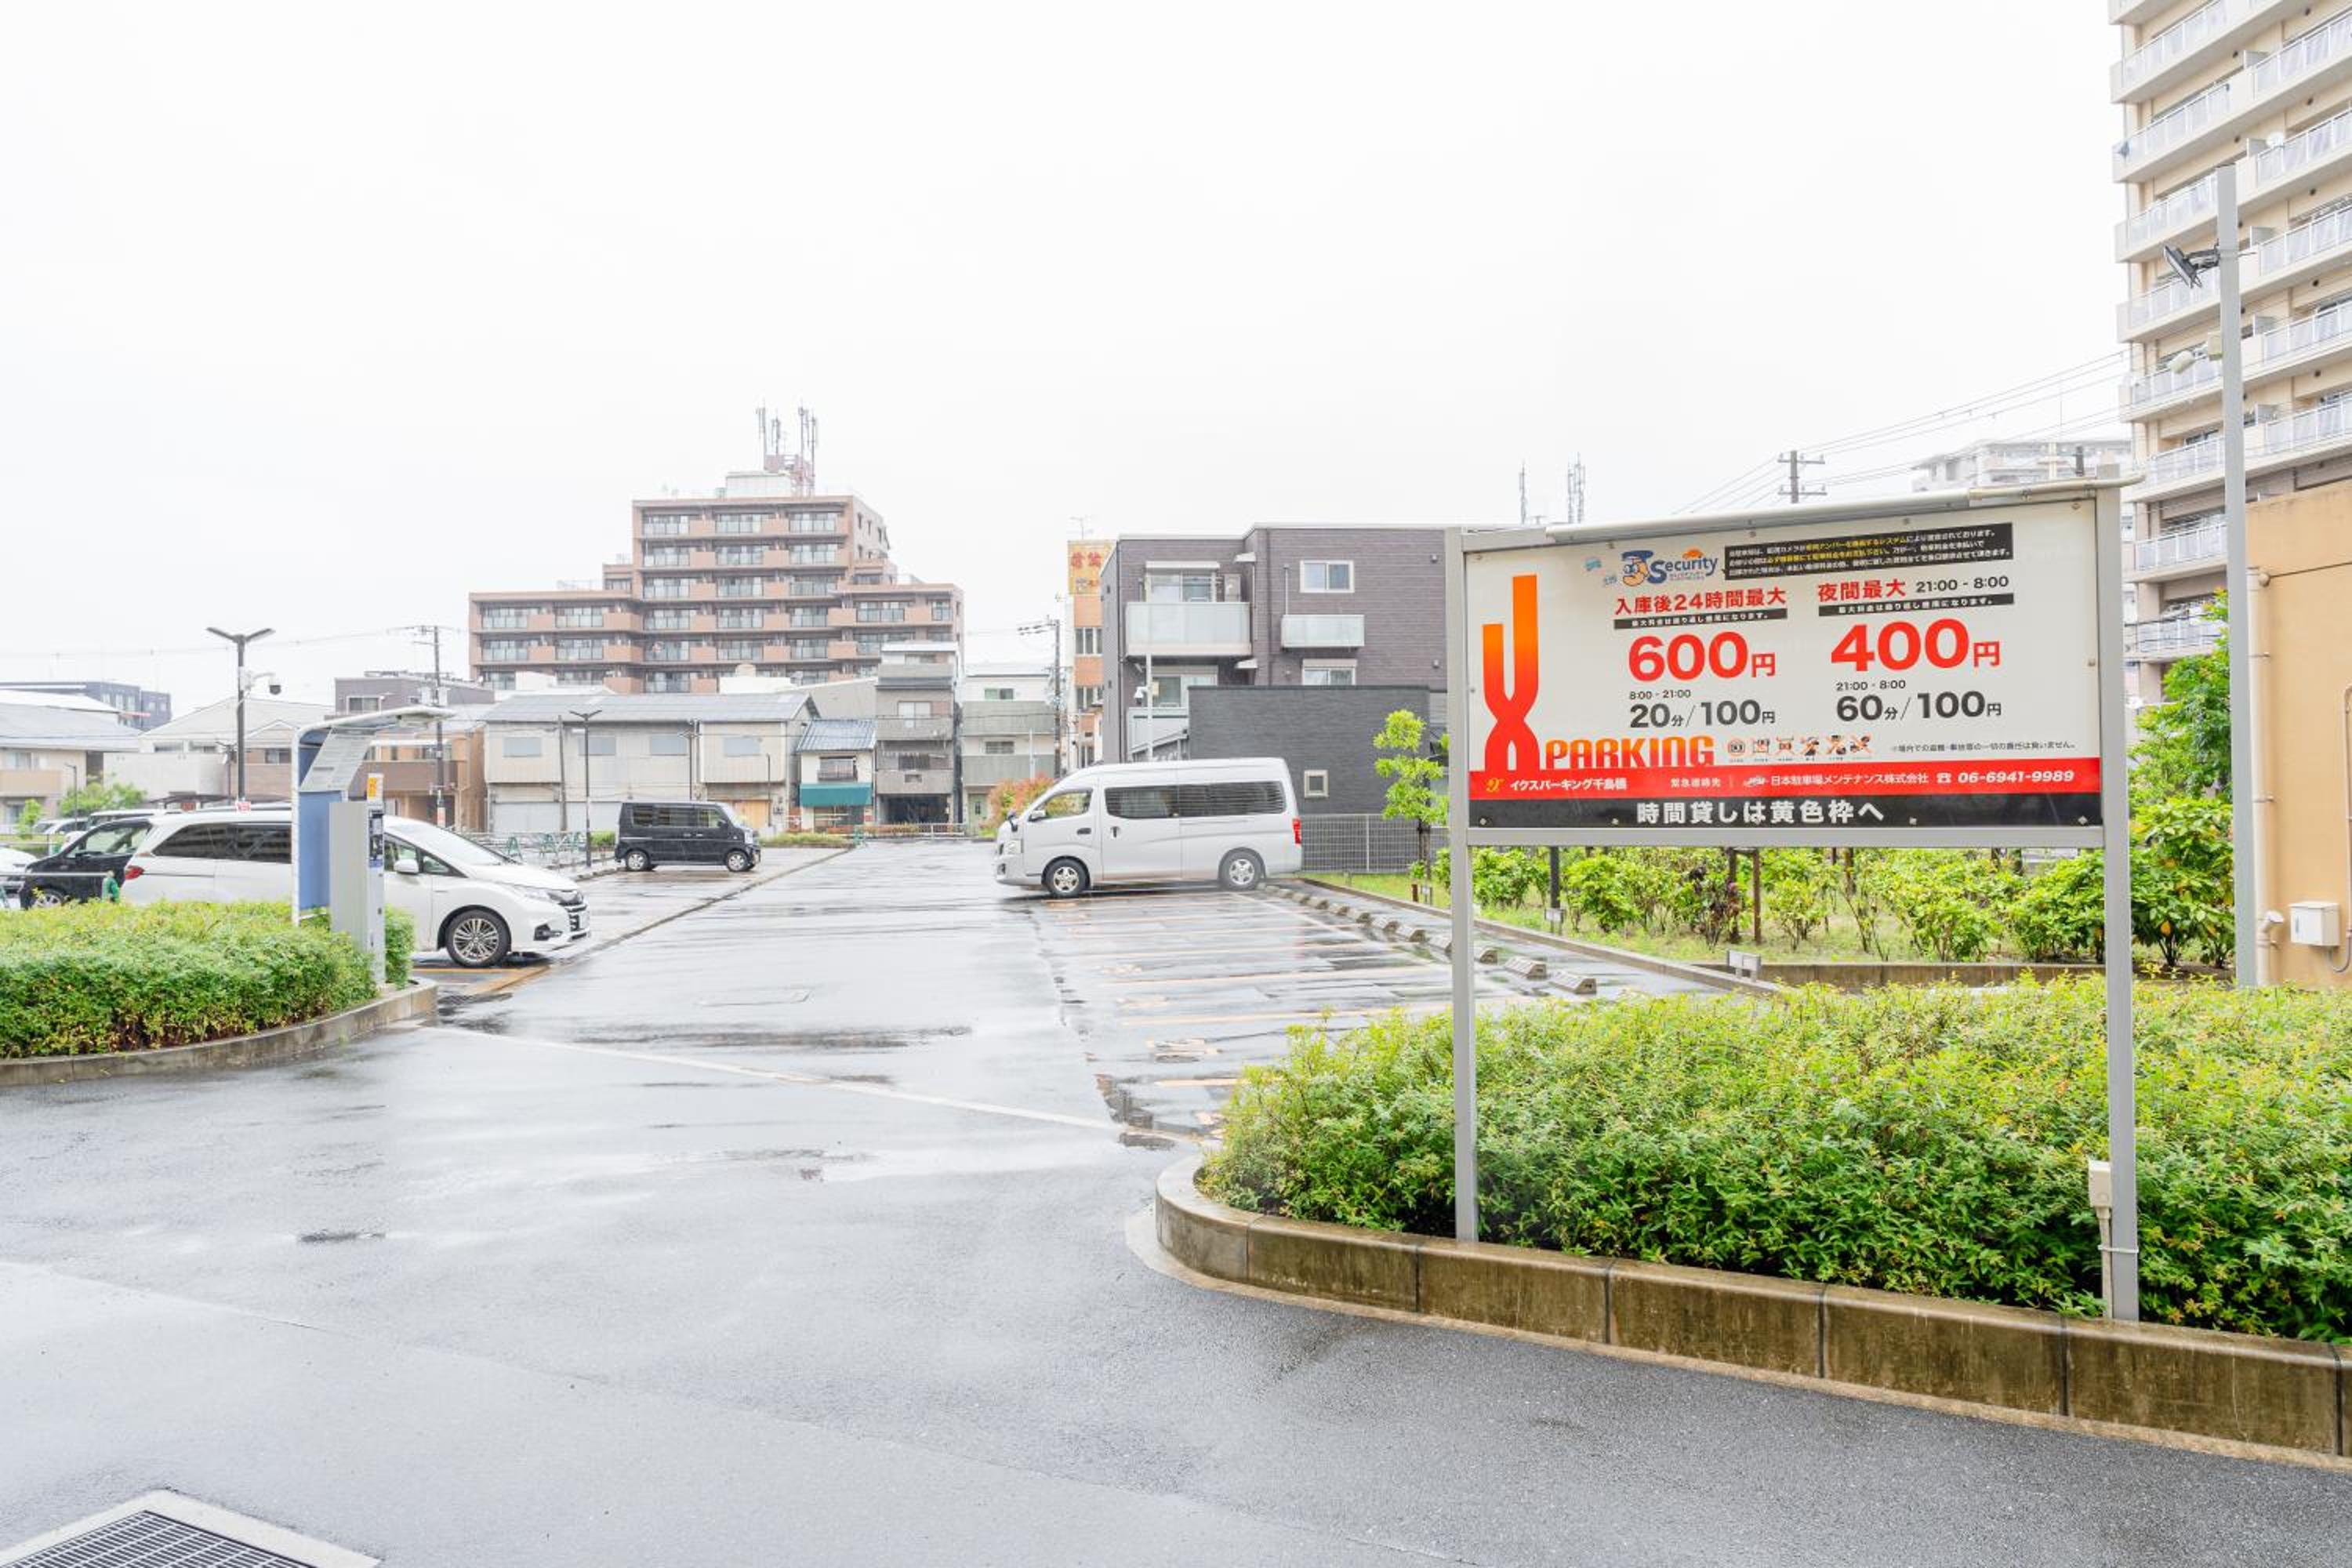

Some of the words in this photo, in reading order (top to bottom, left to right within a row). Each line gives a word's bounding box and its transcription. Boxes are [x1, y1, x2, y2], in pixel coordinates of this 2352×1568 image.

[1615, 586, 1786, 615] 入庫後24時間最大
[1817, 579, 1906, 602] 夜間最大
[1916, 579, 1958, 593] 21:00
[1973, 575, 2009, 588] 8:00
[1629, 631, 1776, 682] 600円
[1831, 618, 2000, 671] 400円
[1629, 691, 1652, 700] 8:00
[1663, 689, 1691, 698] 21:00
[1836, 681, 1867, 691] 21:00
[1879, 680, 1906, 689] 8:00
[1545, 735, 1715, 769] PARKING
[1771, 773, 1929, 786] 日本駐車場メンテナンス株式会社
[1958, 770, 2074, 783] 06-6941-9989
[1637, 800, 1884, 824] 時間貸しは黄色枠へ
